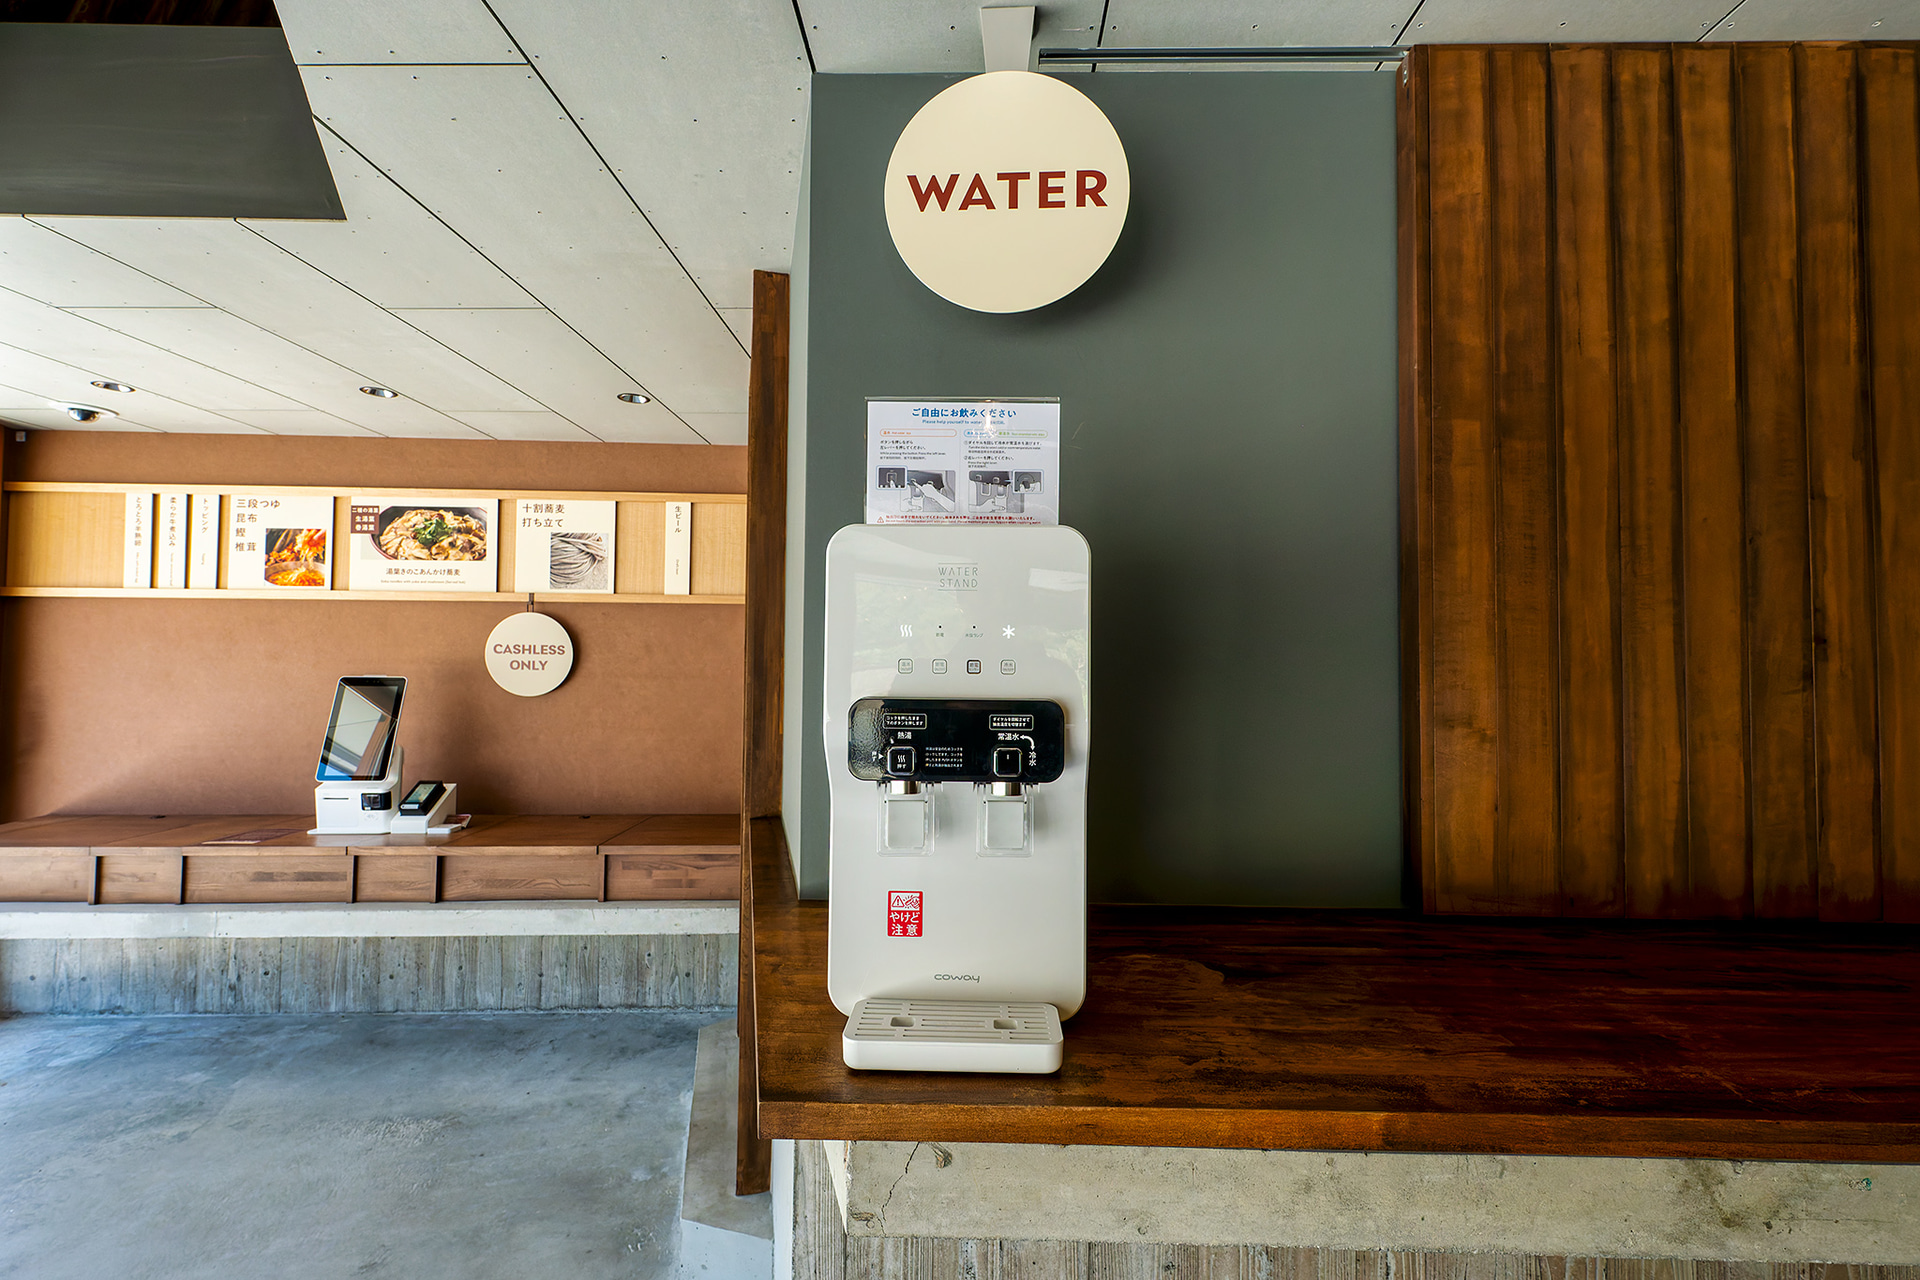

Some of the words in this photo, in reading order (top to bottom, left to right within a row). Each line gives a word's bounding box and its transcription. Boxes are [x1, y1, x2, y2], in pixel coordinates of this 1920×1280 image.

[907, 170, 1108, 212] WATER
[911, 407, 1016, 418] ご自由にお飲みください
[236, 498, 280, 508] 三段つゆ
[522, 503, 565, 513] 十割蕎麦
[236, 513, 257, 523] 昆布
[522, 517, 564, 527] 打ち立て
[674, 505, 682, 533] 生ビール
[235, 527, 246, 537] 鰹
[235, 542, 256, 552] 椎茸
[938, 567, 978, 576] WATER
[939, 579, 978, 588] STAND
[493, 643, 566, 655] CASHLESS
[509, 660, 548, 670] ONLY
[998, 733, 1020, 741] 常温水
[1028, 751, 1037, 767] 冷水
[889, 912, 920, 923] やけど
[891, 924, 918, 936] 注意
[934, 974, 980, 983] coway
